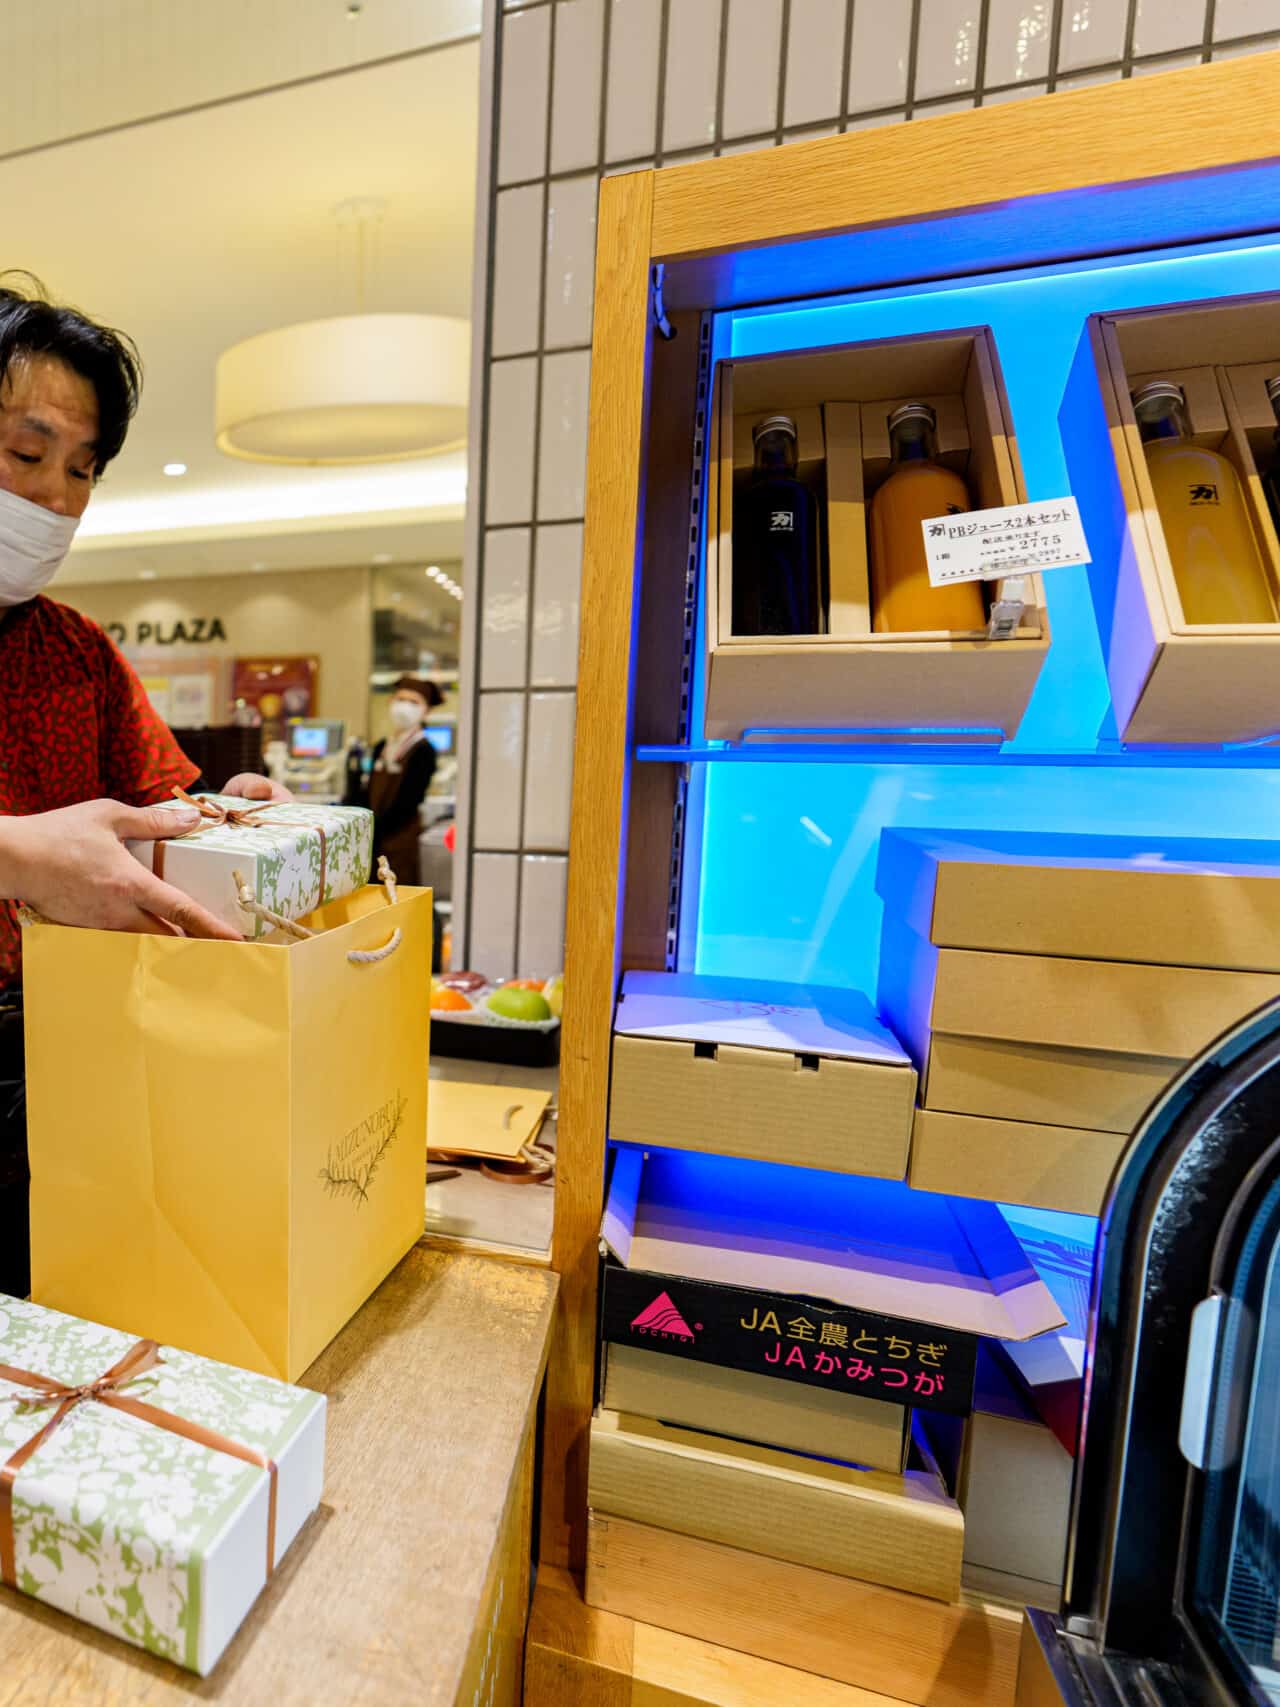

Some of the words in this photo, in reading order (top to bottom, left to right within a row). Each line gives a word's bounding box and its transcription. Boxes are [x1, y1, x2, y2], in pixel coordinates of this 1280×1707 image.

[136, 618, 227, 645] PLAZA
[740, 1307, 948, 1367] JA全農とちぎ
[765, 1342, 944, 1396] JAかみつが
